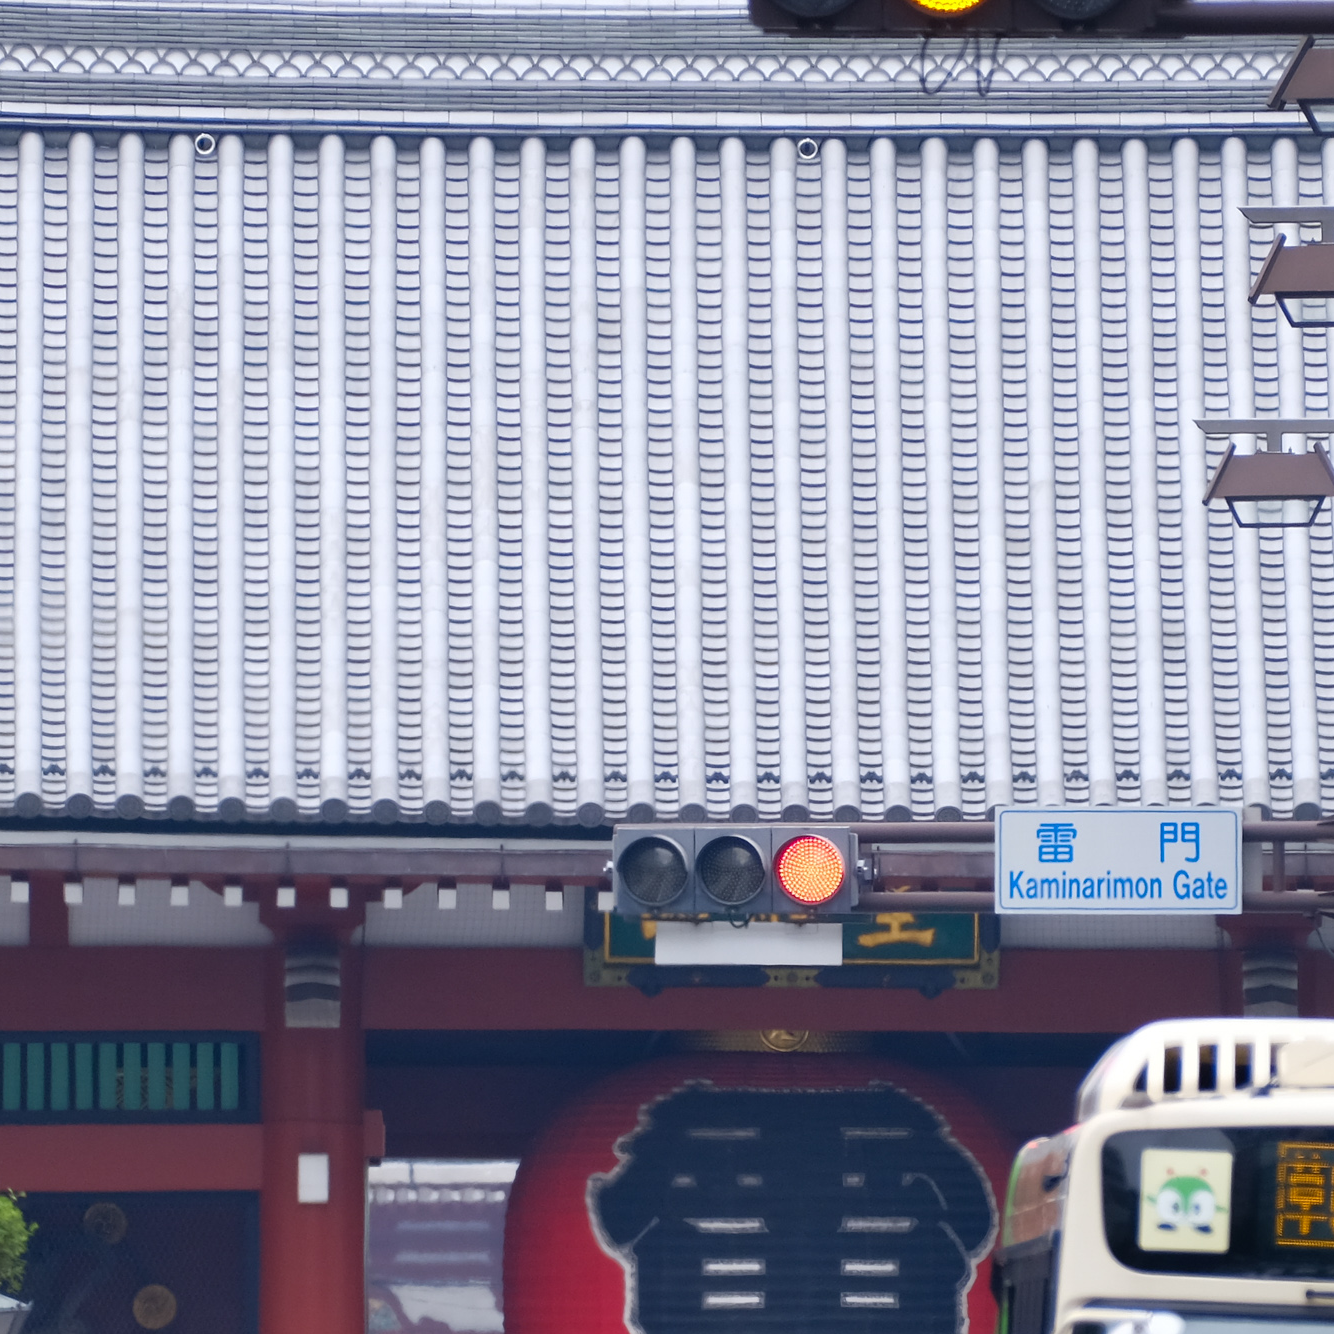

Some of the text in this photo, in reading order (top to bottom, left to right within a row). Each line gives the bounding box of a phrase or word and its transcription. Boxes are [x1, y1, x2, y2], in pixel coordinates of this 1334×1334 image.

[1036, 822, 1201, 864] 雷門
[1008, 869, 1229, 900] Kaminarimon Gate
